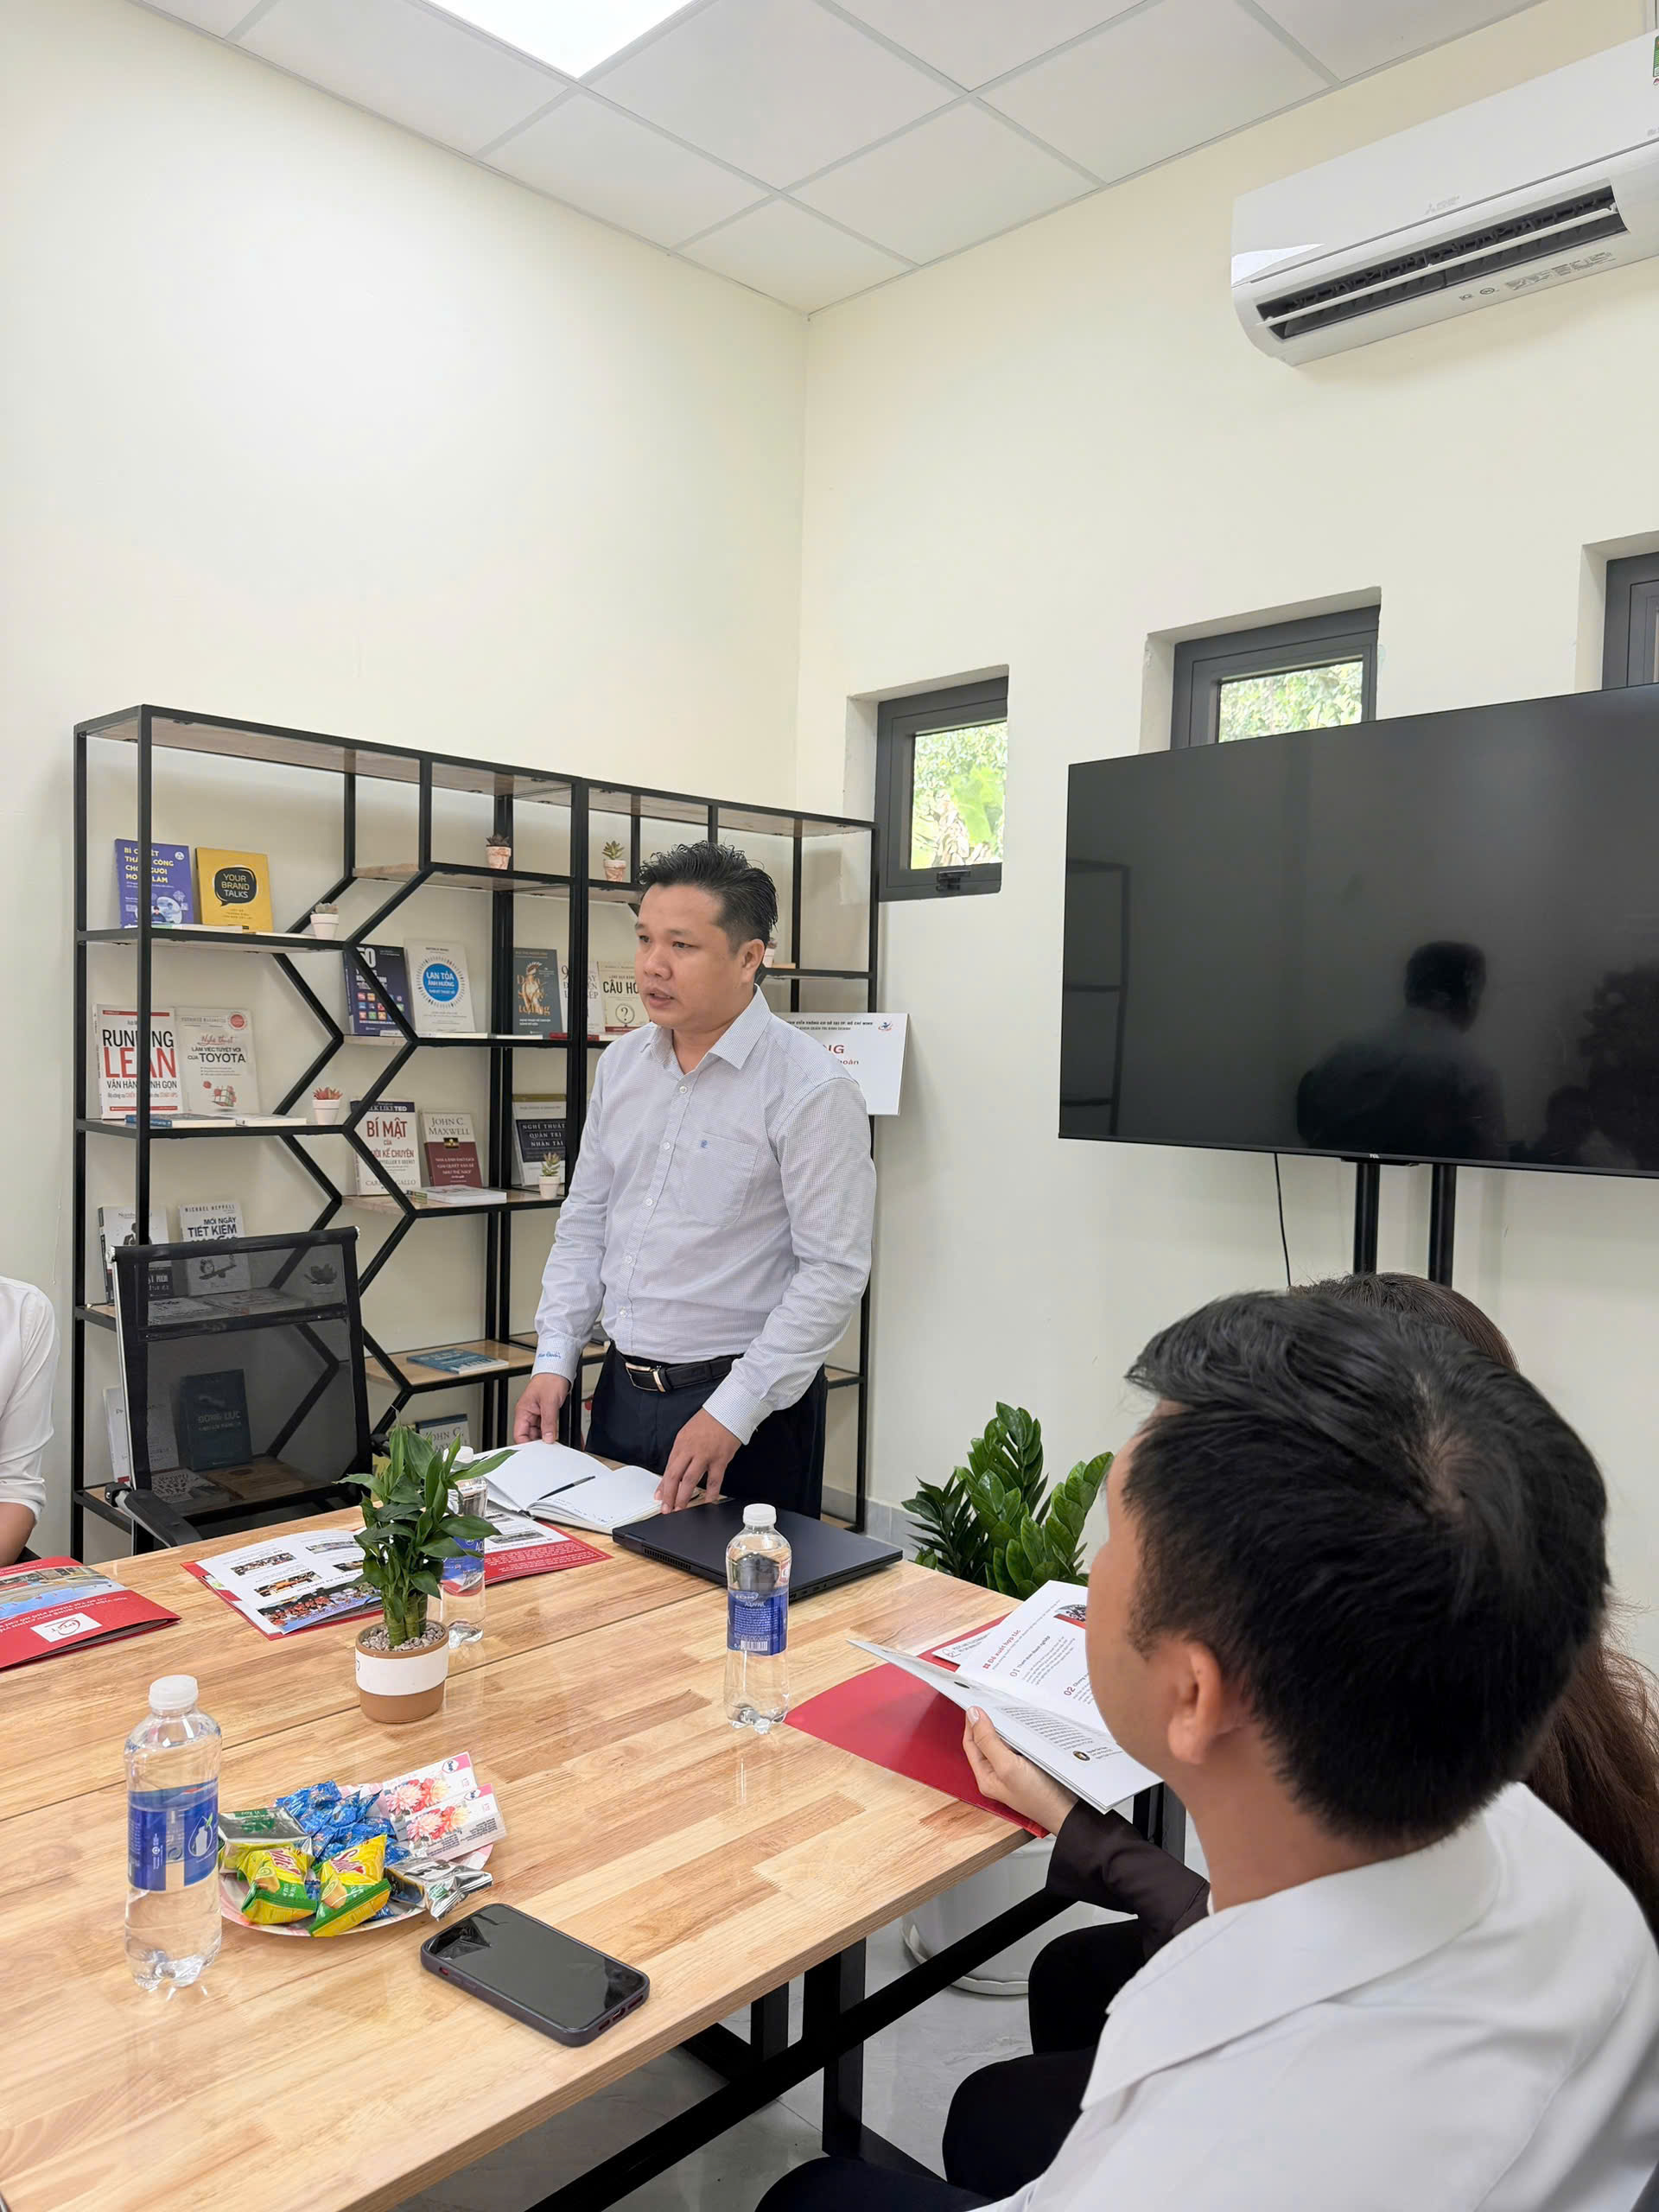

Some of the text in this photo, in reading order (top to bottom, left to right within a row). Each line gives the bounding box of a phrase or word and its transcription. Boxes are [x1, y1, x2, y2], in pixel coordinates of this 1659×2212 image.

[223, 874, 246, 882] YOUR
[221, 881, 250, 891] BRAND
[224, 889, 249, 899] TALKS
[602, 979, 623, 994] CÂU
[102, 1029, 175, 1048] RUNNG
[199, 1052, 246, 1063] TOYOTA
[106, 1078, 121, 1090] VẬN
[123, 1078, 138, 1090] HÀN
[162, 1080, 177, 1090] GỌN
[432, 1117, 454, 1127] JOHN
[366, 1116, 407, 1139] BÍ MẬT
[429, 1127, 471, 1135] MAXWELL
[1009, 1669, 1020, 1677] 01
[1064, 1686, 1076, 1696] 02
